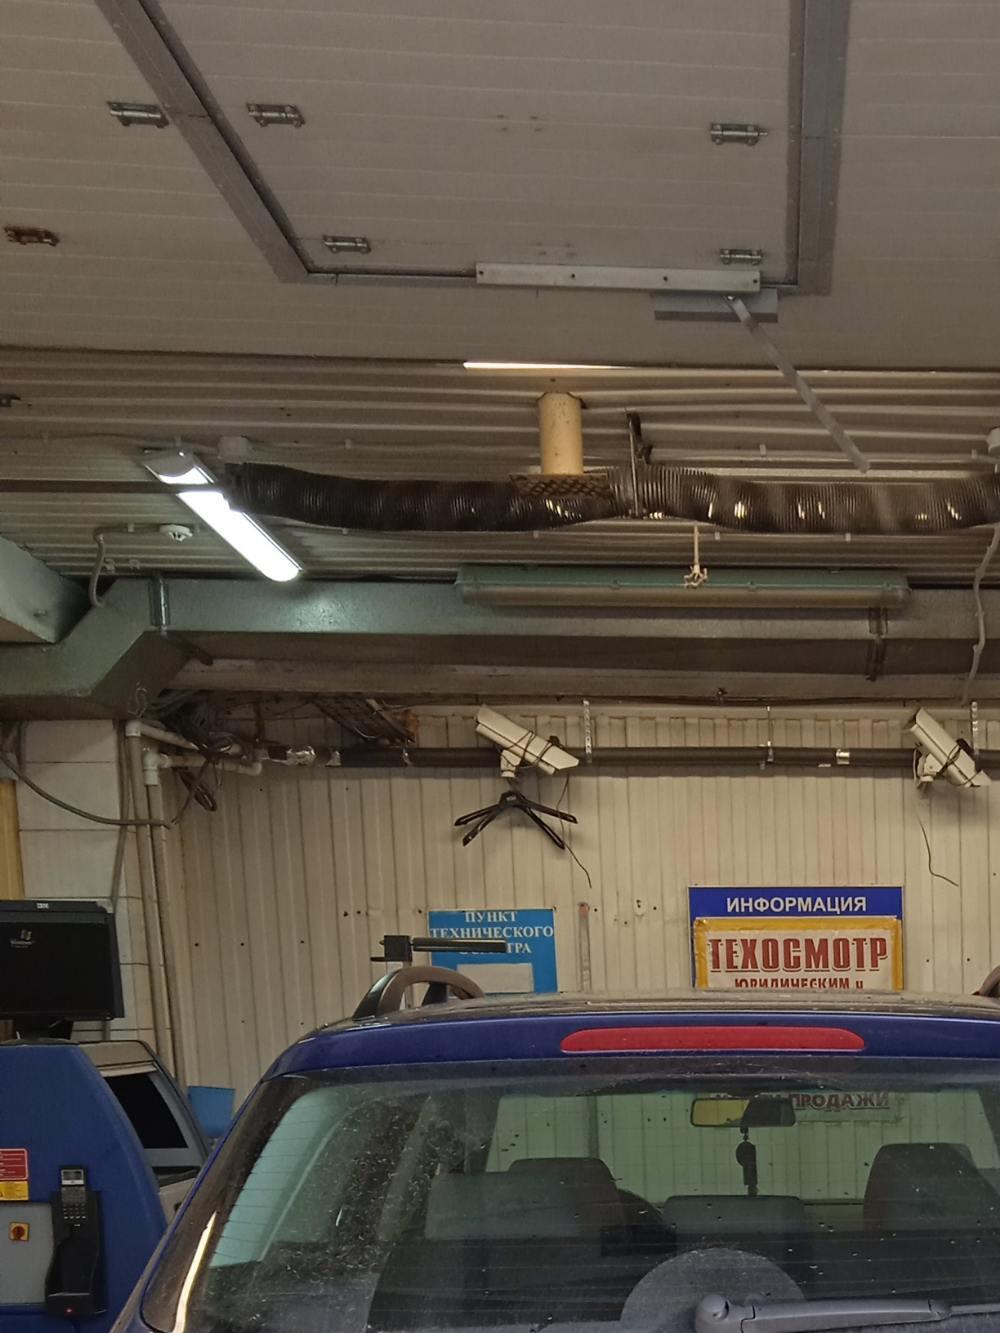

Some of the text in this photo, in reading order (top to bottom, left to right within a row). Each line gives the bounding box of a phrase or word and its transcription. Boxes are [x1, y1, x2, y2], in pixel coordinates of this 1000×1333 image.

[726, 896, 866, 914] ИНФОРМАЦИЯ
[465, 911, 517, 922] ПУНКТ
[430, 926, 553, 938] ТЕХНИЧЕСКОГО
[708, 937, 888, 973] ТЕХОСМОТР
